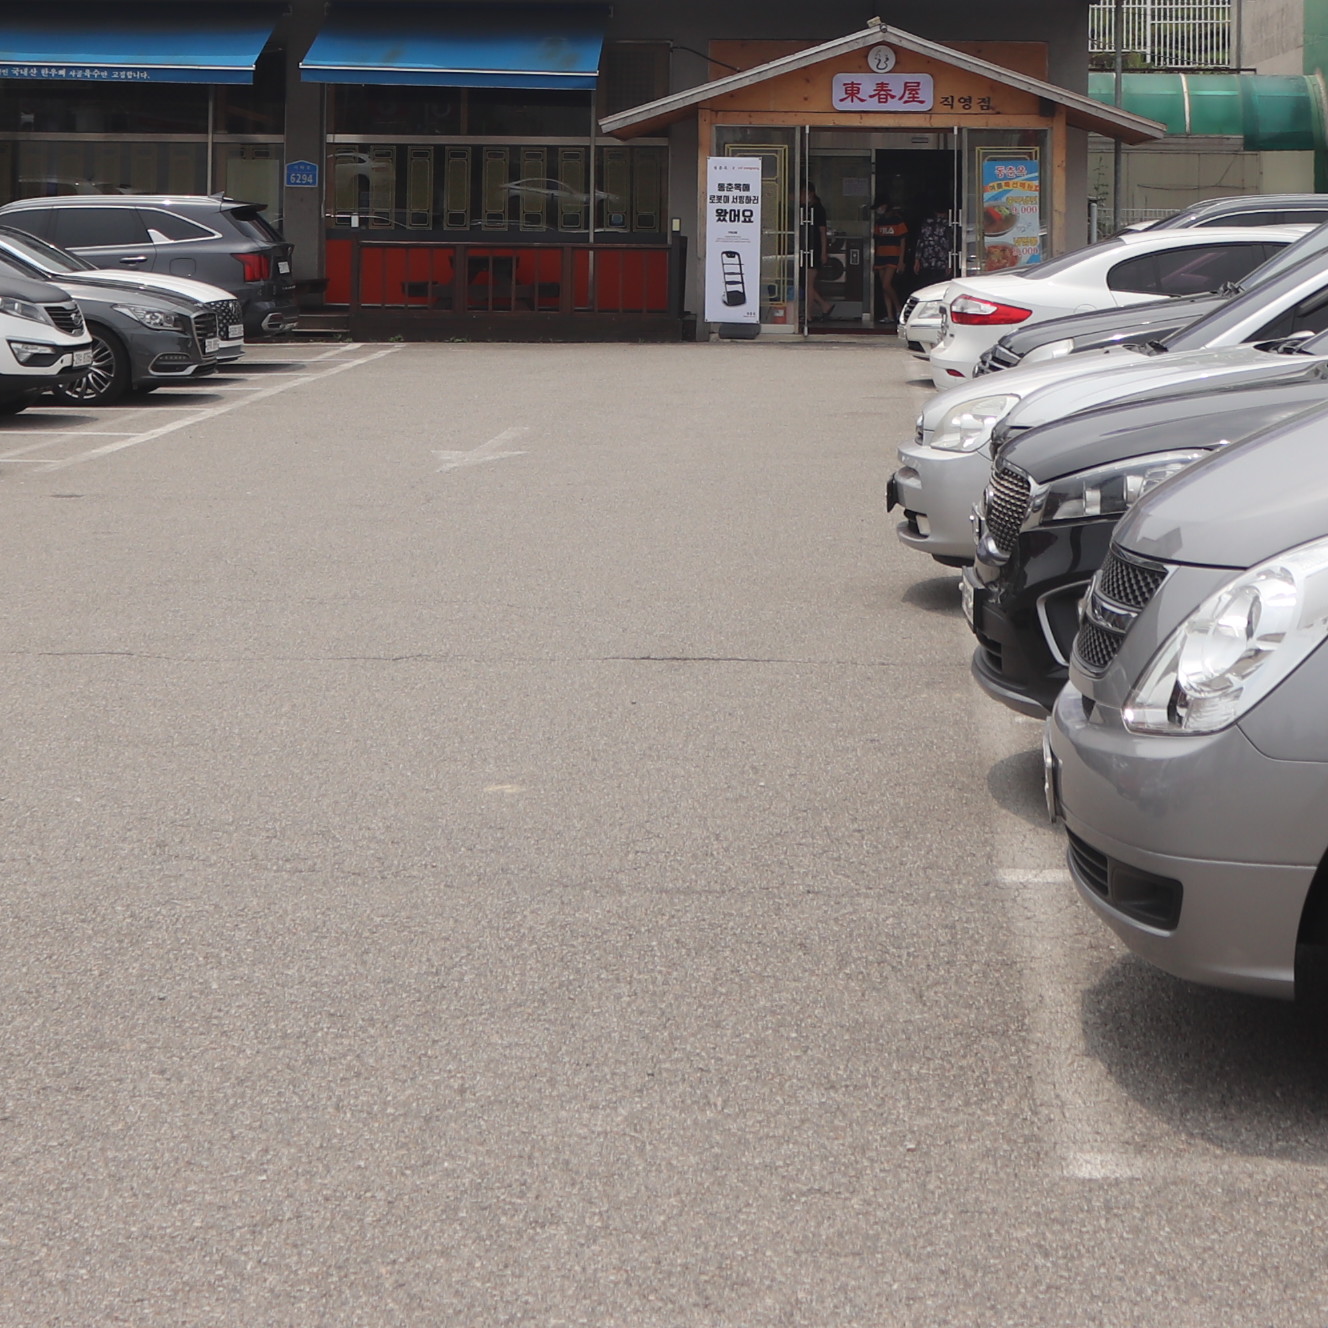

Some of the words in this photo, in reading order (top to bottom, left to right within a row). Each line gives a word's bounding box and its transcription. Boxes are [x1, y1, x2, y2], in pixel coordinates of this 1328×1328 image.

[839, 81, 926, 104] 東春屋
[940, 96, 992, 110] 직영점
[290, 173, 313, 184] 6294
[709, 195, 730, 204] 로봇이
[731, 195, 759, 204] 서빙하러
[715, 208, 754, 223] 왔어요
